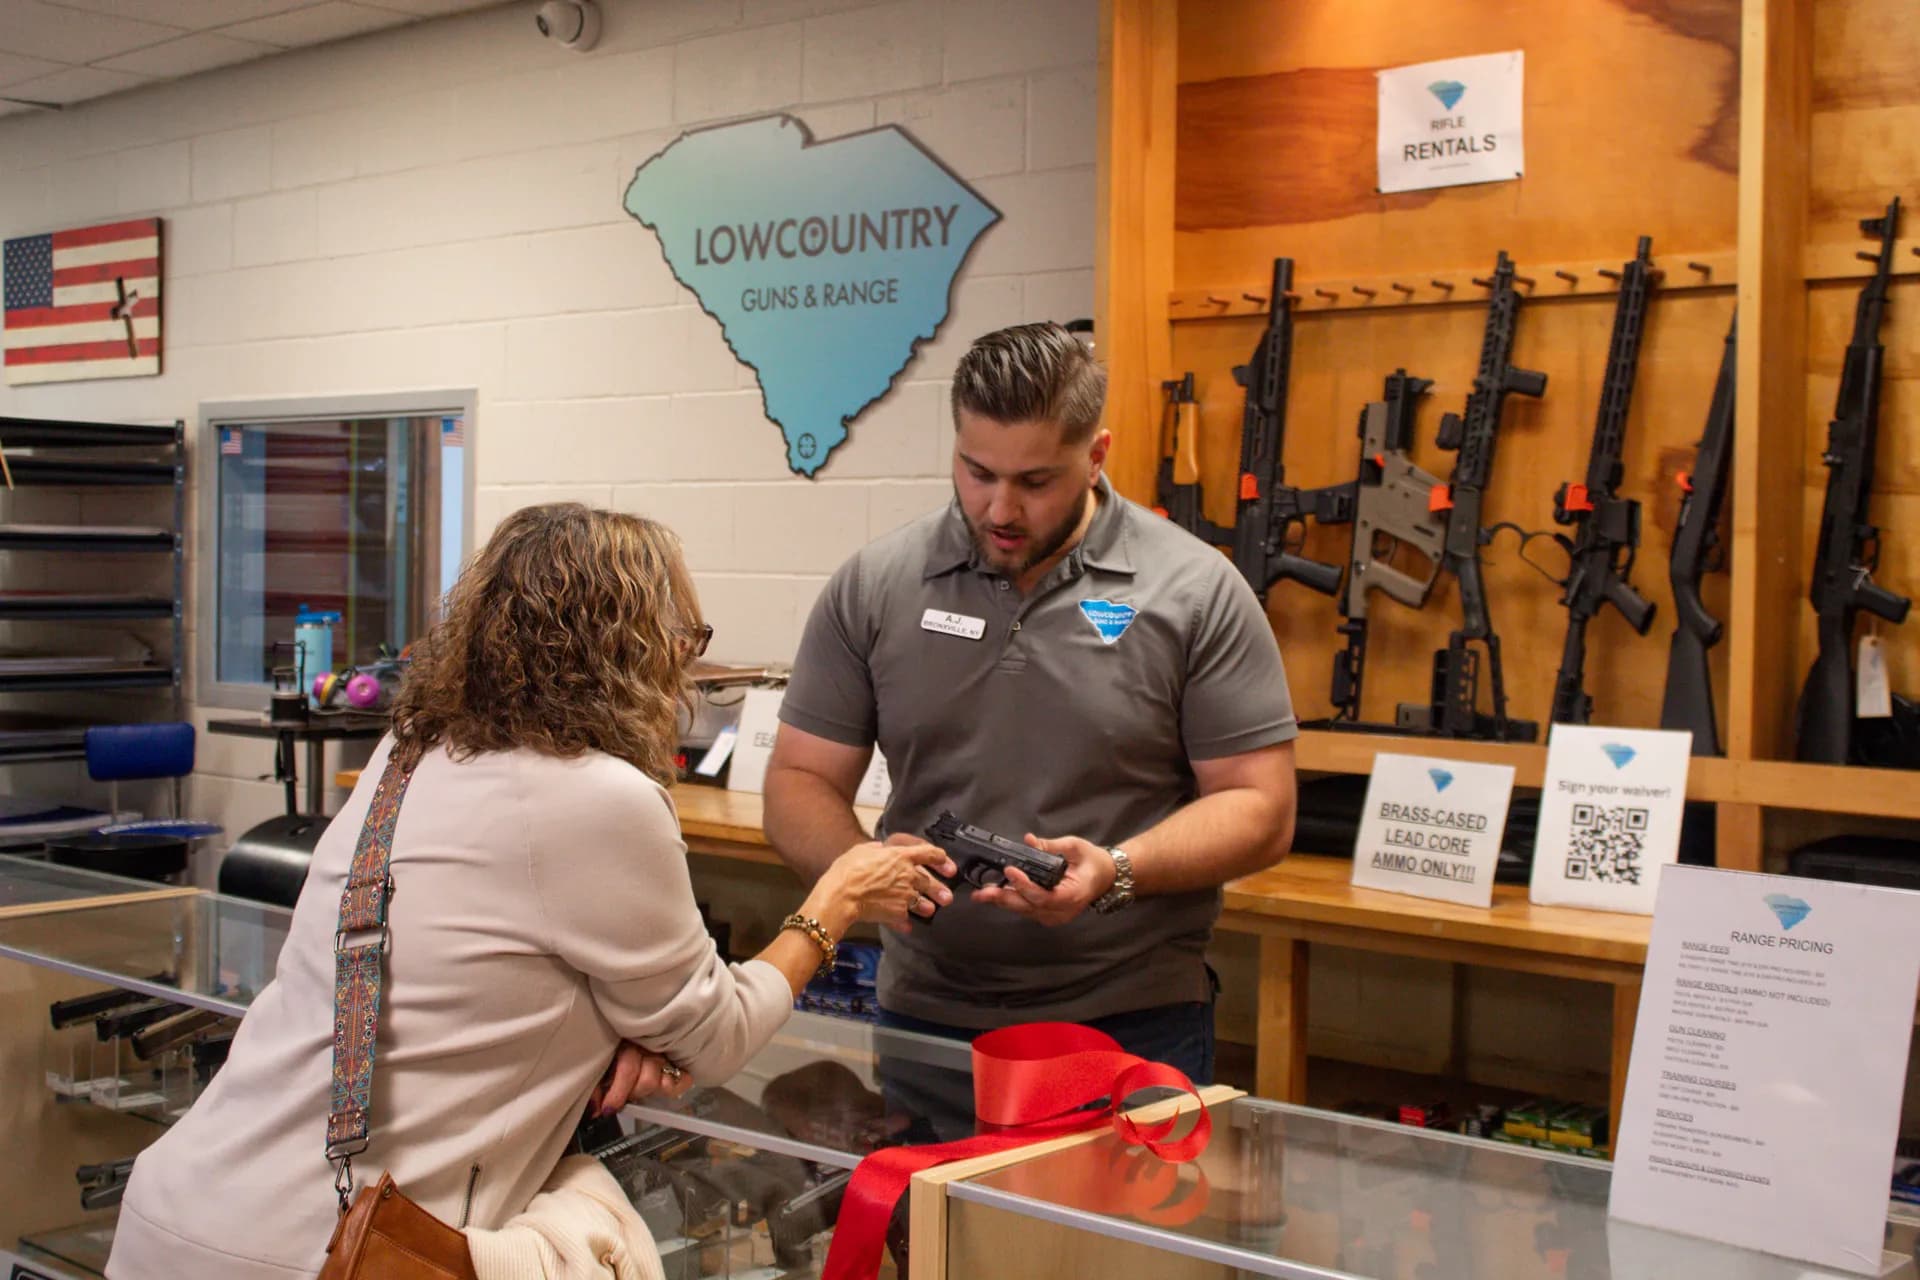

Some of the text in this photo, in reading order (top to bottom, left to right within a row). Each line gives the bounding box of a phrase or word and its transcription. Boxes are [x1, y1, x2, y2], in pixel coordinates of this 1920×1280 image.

[1430, 116, 1465, 131] RIFLE
[1404, 134, 1496, 162] RENTALS
[695, 204, 960, 266] LOWCOUNTRY
[741, 279, 899, 312] GUNS & RANGE
[1558, 780, 1671, 799] Sign your waiver!
[1380, 802, 1488, 831] BRASS-CASED
[1385, 828, 1472, 854] LEAD CORE
[1371, 851, 1476, 882] AMMO ONLY!!!
[1731, 931, 1833, 954] RANGE PRICING
